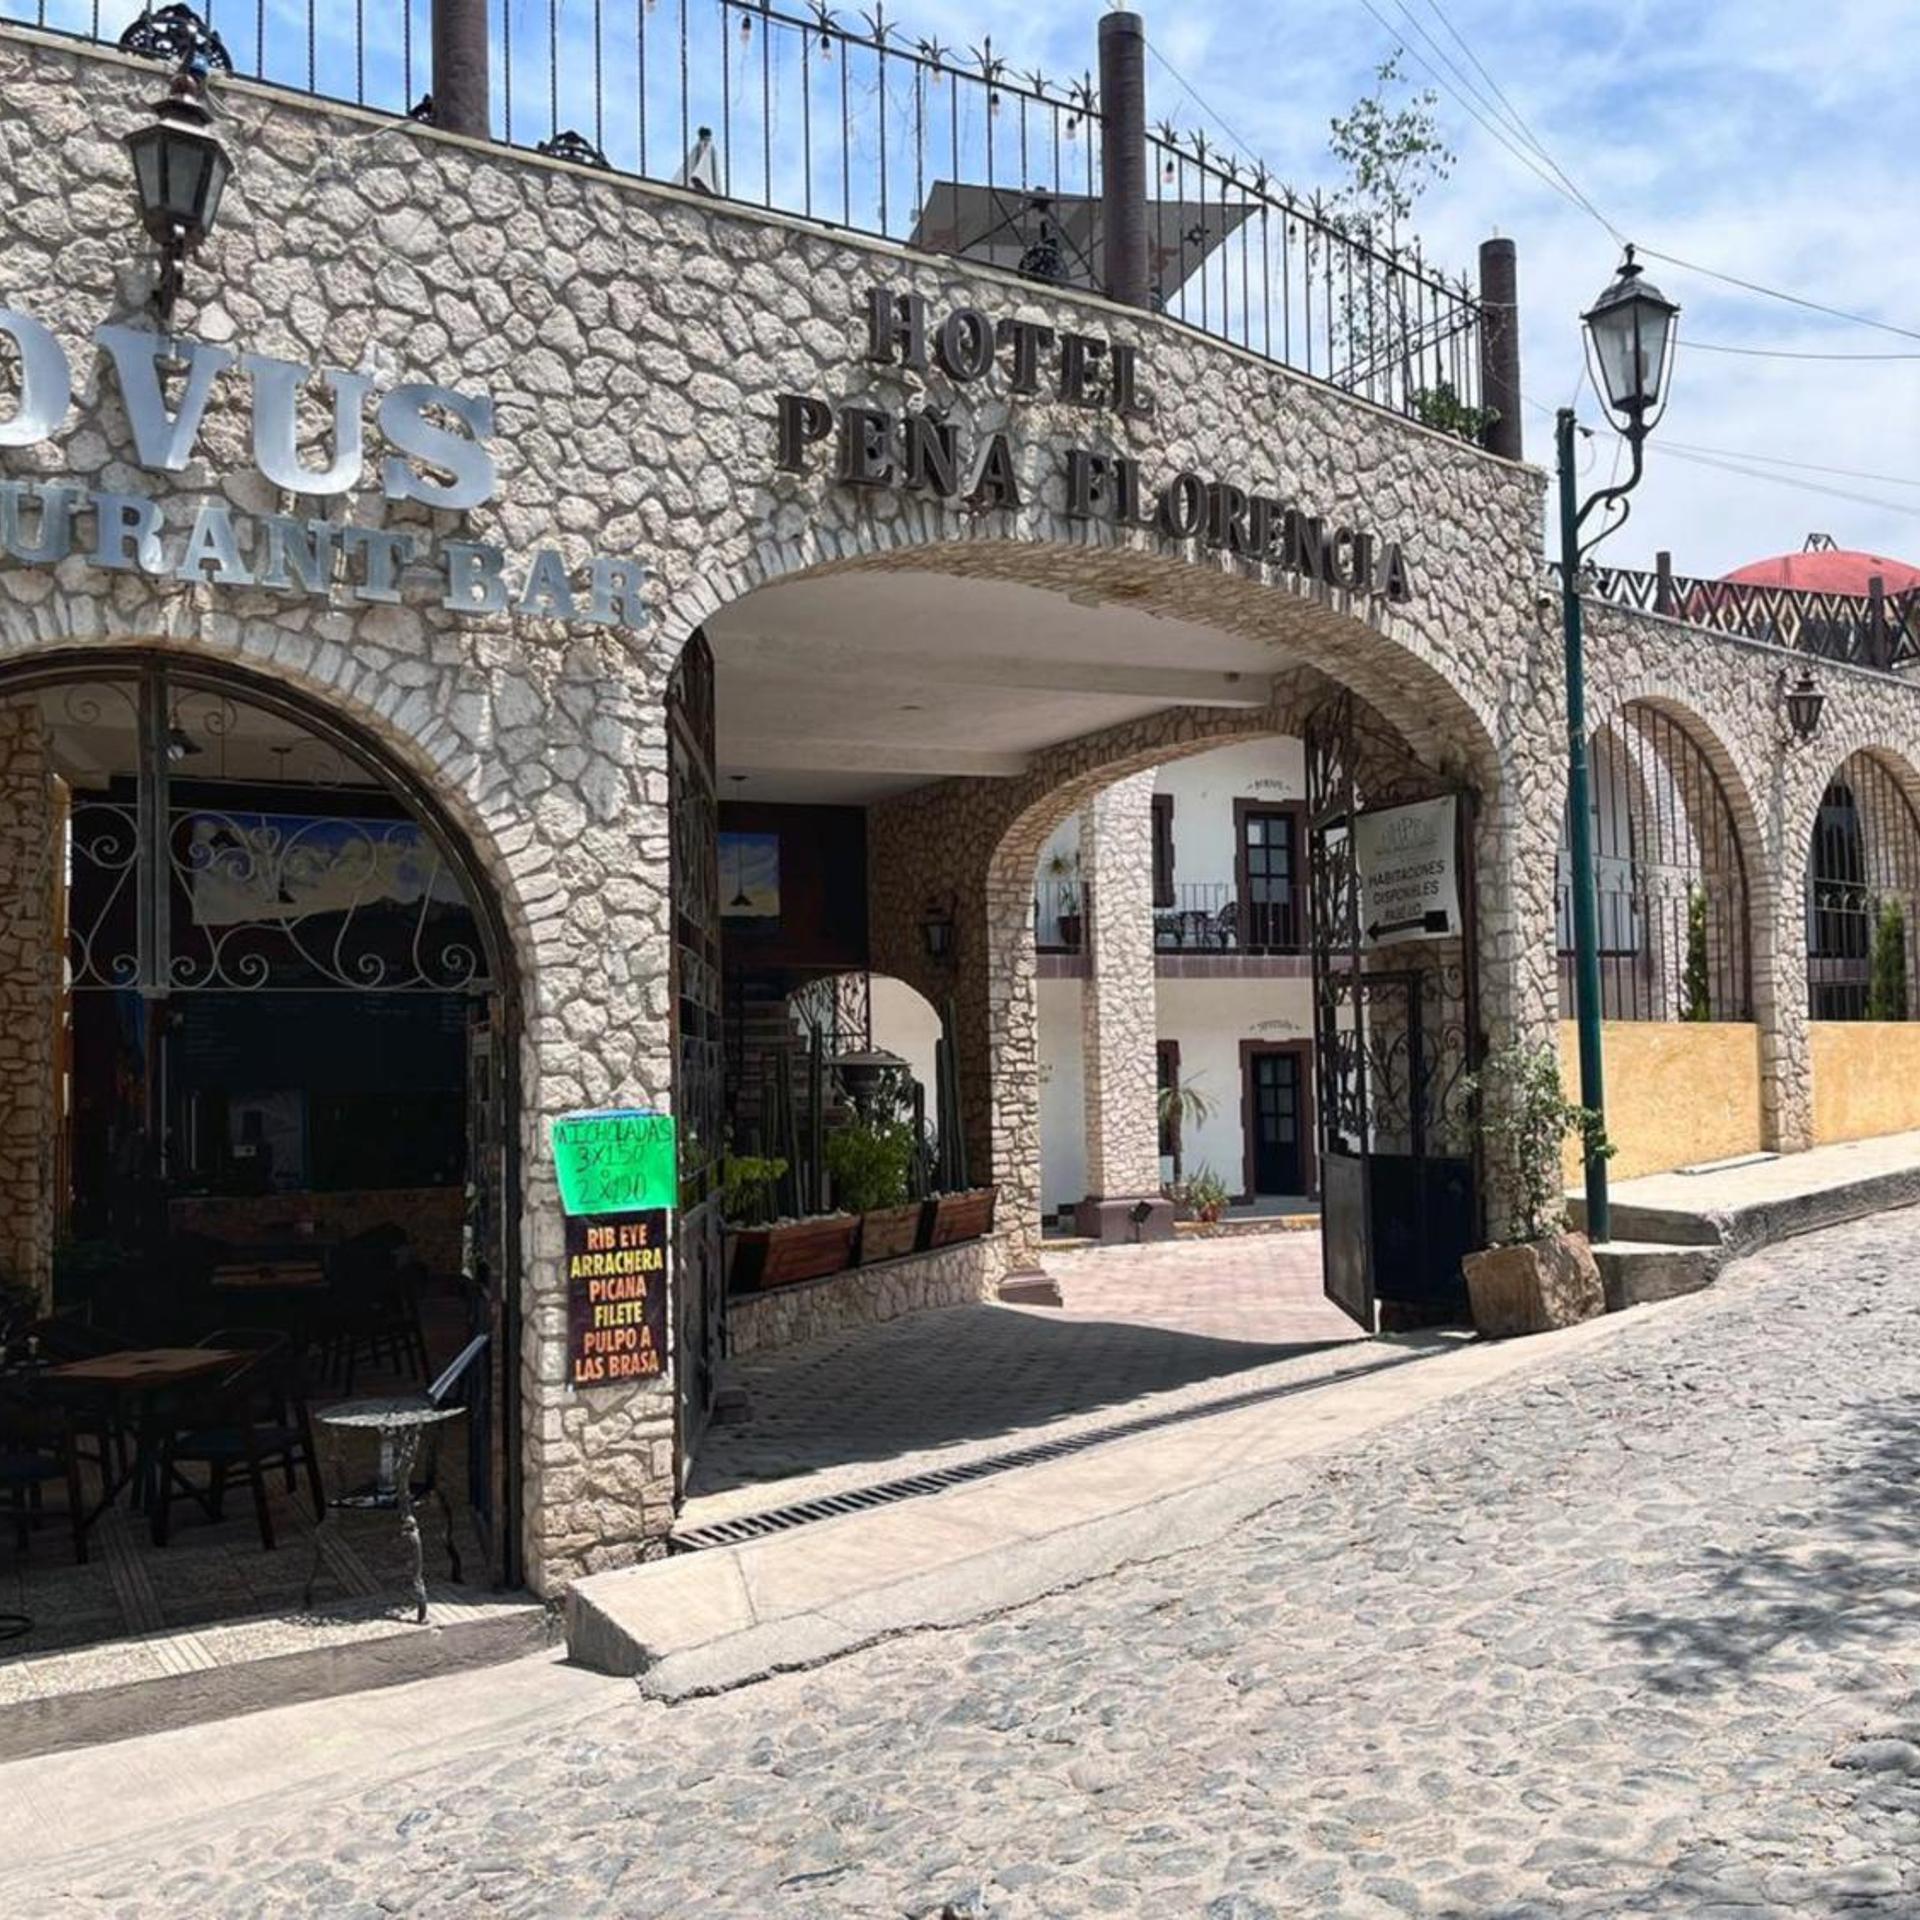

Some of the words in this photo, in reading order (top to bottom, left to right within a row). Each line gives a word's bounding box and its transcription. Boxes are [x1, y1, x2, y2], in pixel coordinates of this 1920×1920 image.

[867, 286, 1157, 420] HOTEL
[776, 394, 1022, 509] PEÑA
[1066, 449, 1413, 602] FLORENCIA
[443, 541, 652, 630] BAR
[587, 1225, 616, 1250] RIB
[620, 1223, 648, 1247] EYE
[570, 1248, 664, 1279] ARRACHERA
[594, 1301, 643, 1328] FILETE
[584, 1328, 638, 1355] PULPO
[640, 1325, 651, 1348] A
[575, 1356, 604, 1382] LAS
[608, 1349, 660, 1378] BRASA
